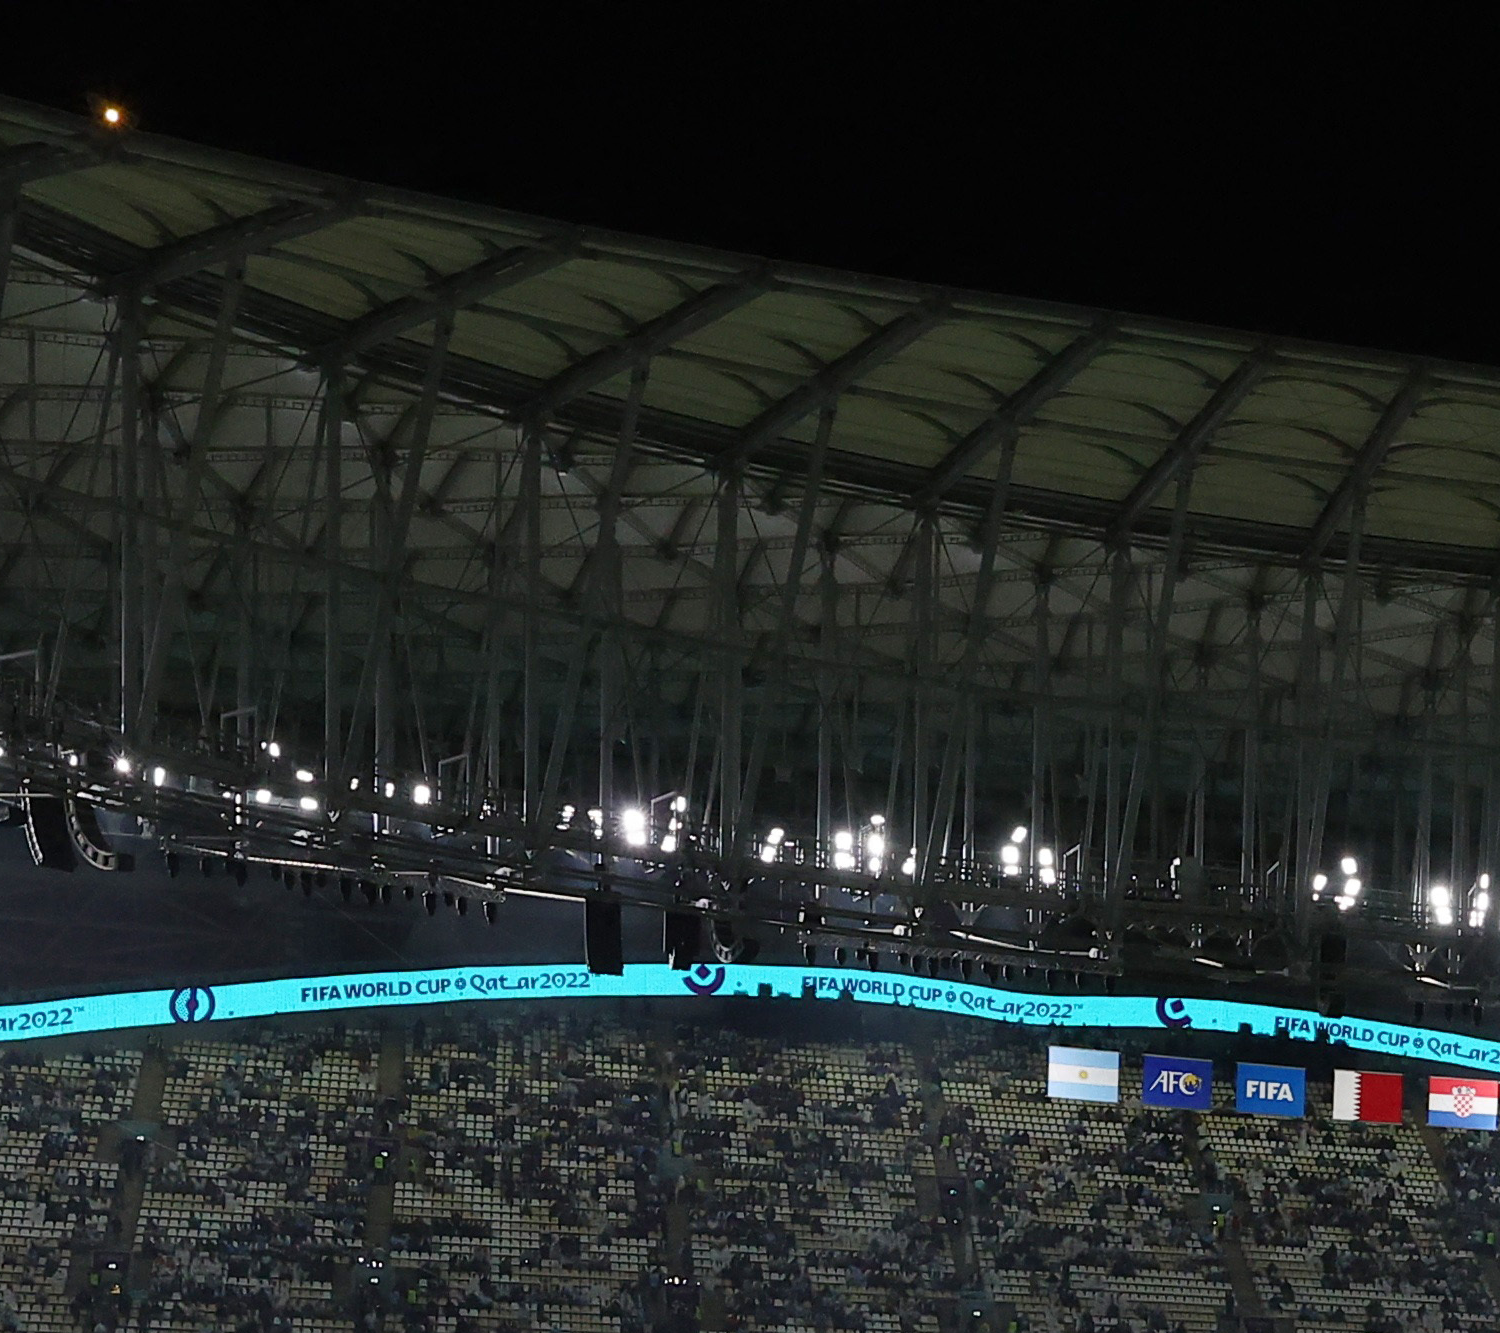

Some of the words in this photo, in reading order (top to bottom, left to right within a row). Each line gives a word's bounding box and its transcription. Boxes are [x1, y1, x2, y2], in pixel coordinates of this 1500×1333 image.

[301, 986, 342, 1003] FIFA
[344, 982, 412, 999] WORLD
[415, 978, 451, 995] CUP
[908, 985, 942, 1003] CUP
[1377, 1031, 1410, 1048] CUP
[1246, 1080, 1294, 1102] FIFA
